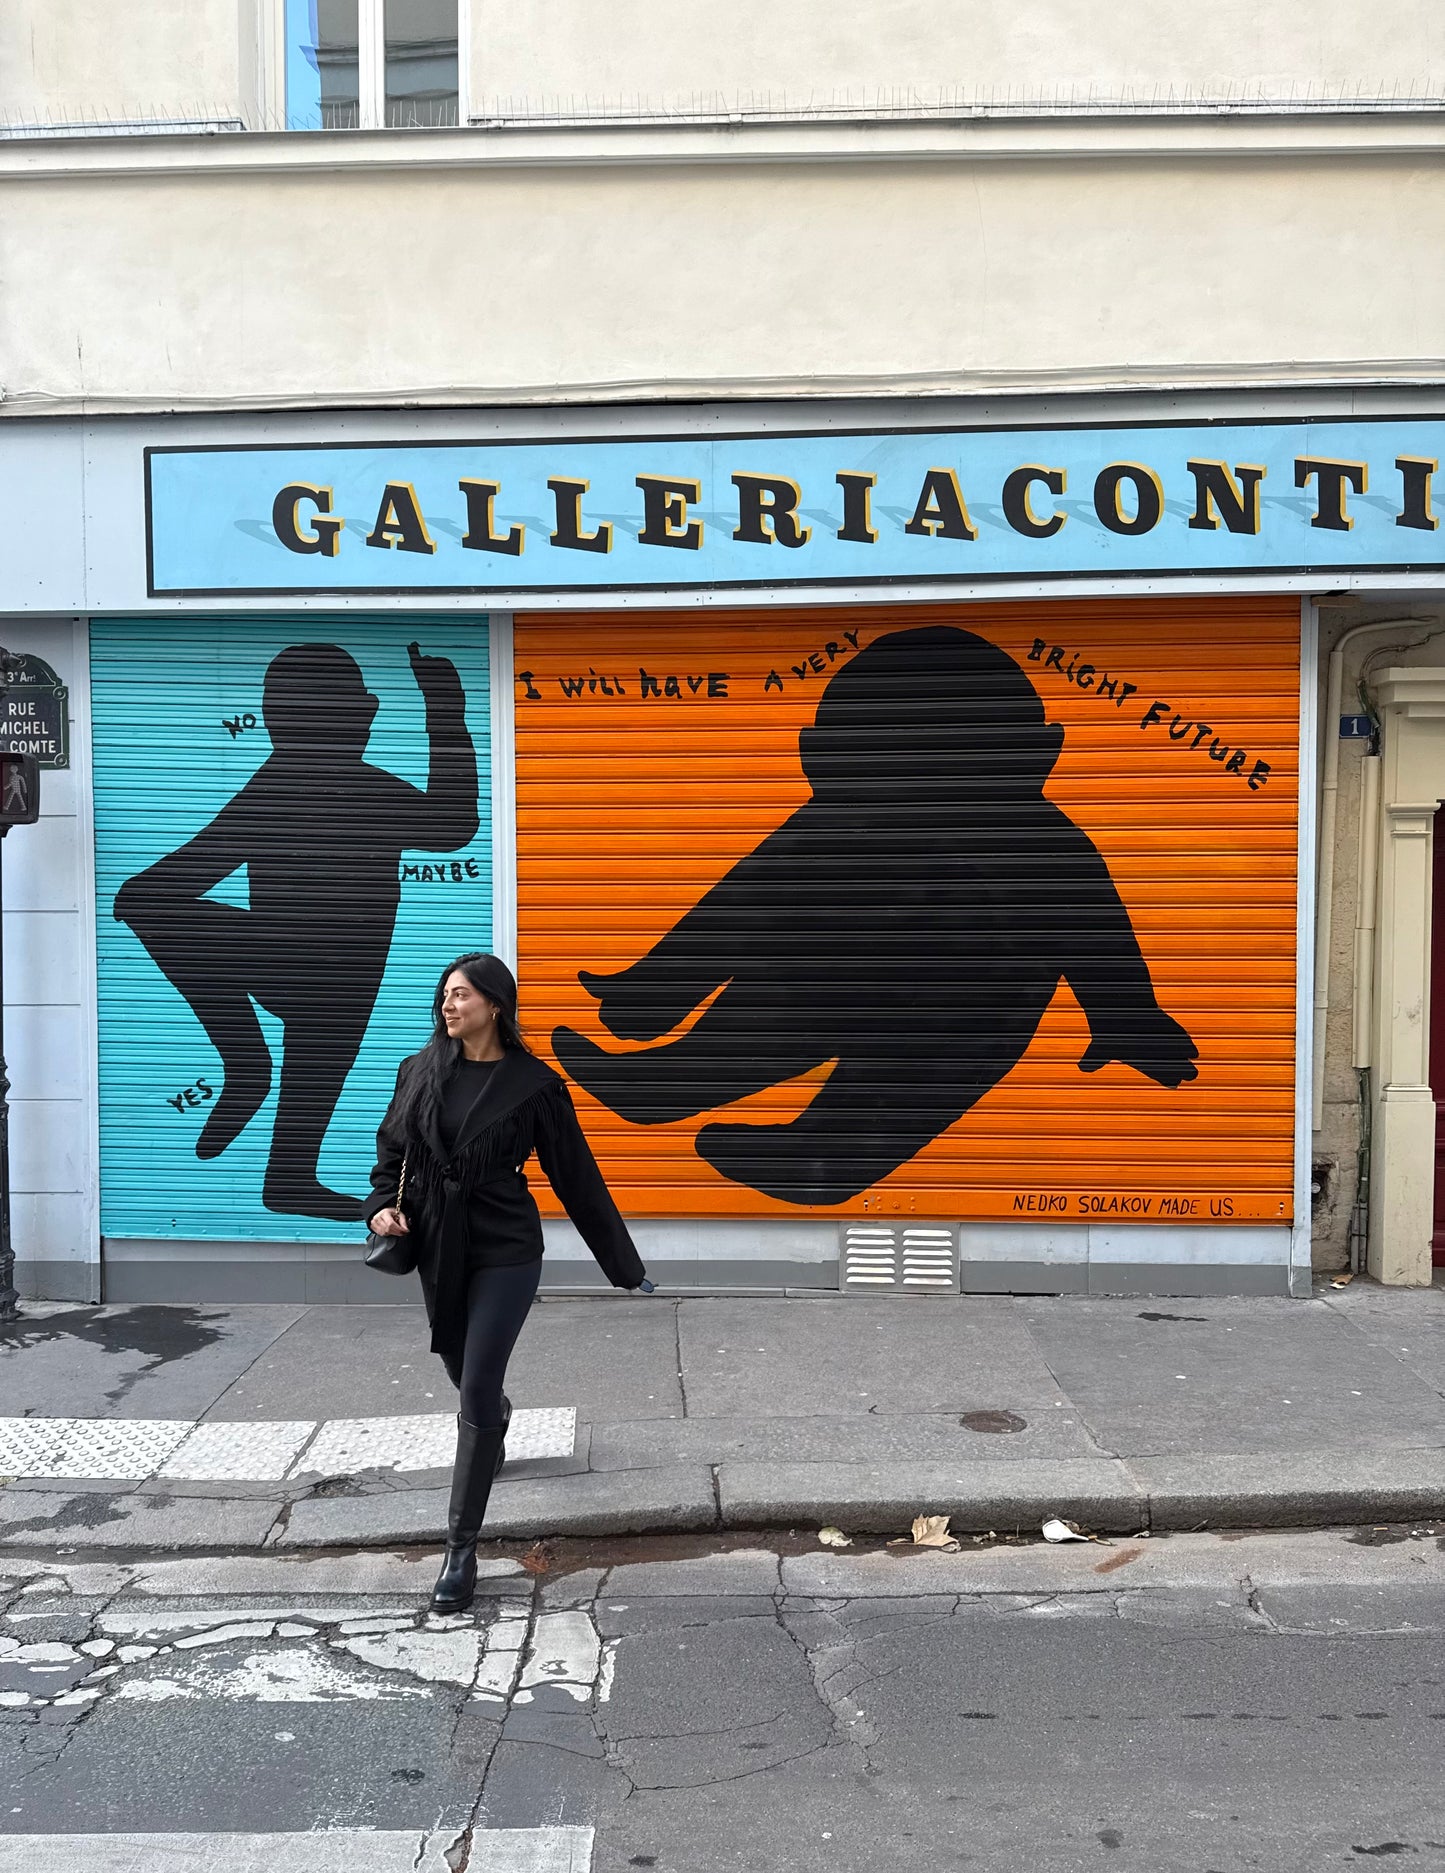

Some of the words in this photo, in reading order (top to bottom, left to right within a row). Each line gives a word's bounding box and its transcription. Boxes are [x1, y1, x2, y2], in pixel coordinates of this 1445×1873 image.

[8, 702, 36, 716] RUE
[518, 670, 542, 699] I
[763, 669, 784, 692] A
[791, 628, 860, 680] VERY
[1140, 701, 1271, 790] FUTURE
[222, 713, 257, 740] NO
[1350, 718, 1359, 735] 1
[9, 740, 56, 754] COMTE
[401, 858, 480, 882] MAYBE
[166, 1077, 213, 1114] YES
[1012, 1195, 1067, 1212] NEDKO
[1078, 1195, 1152, 1214] SOLAKOV
[1158, 1198, 1200, 1216] MADE
